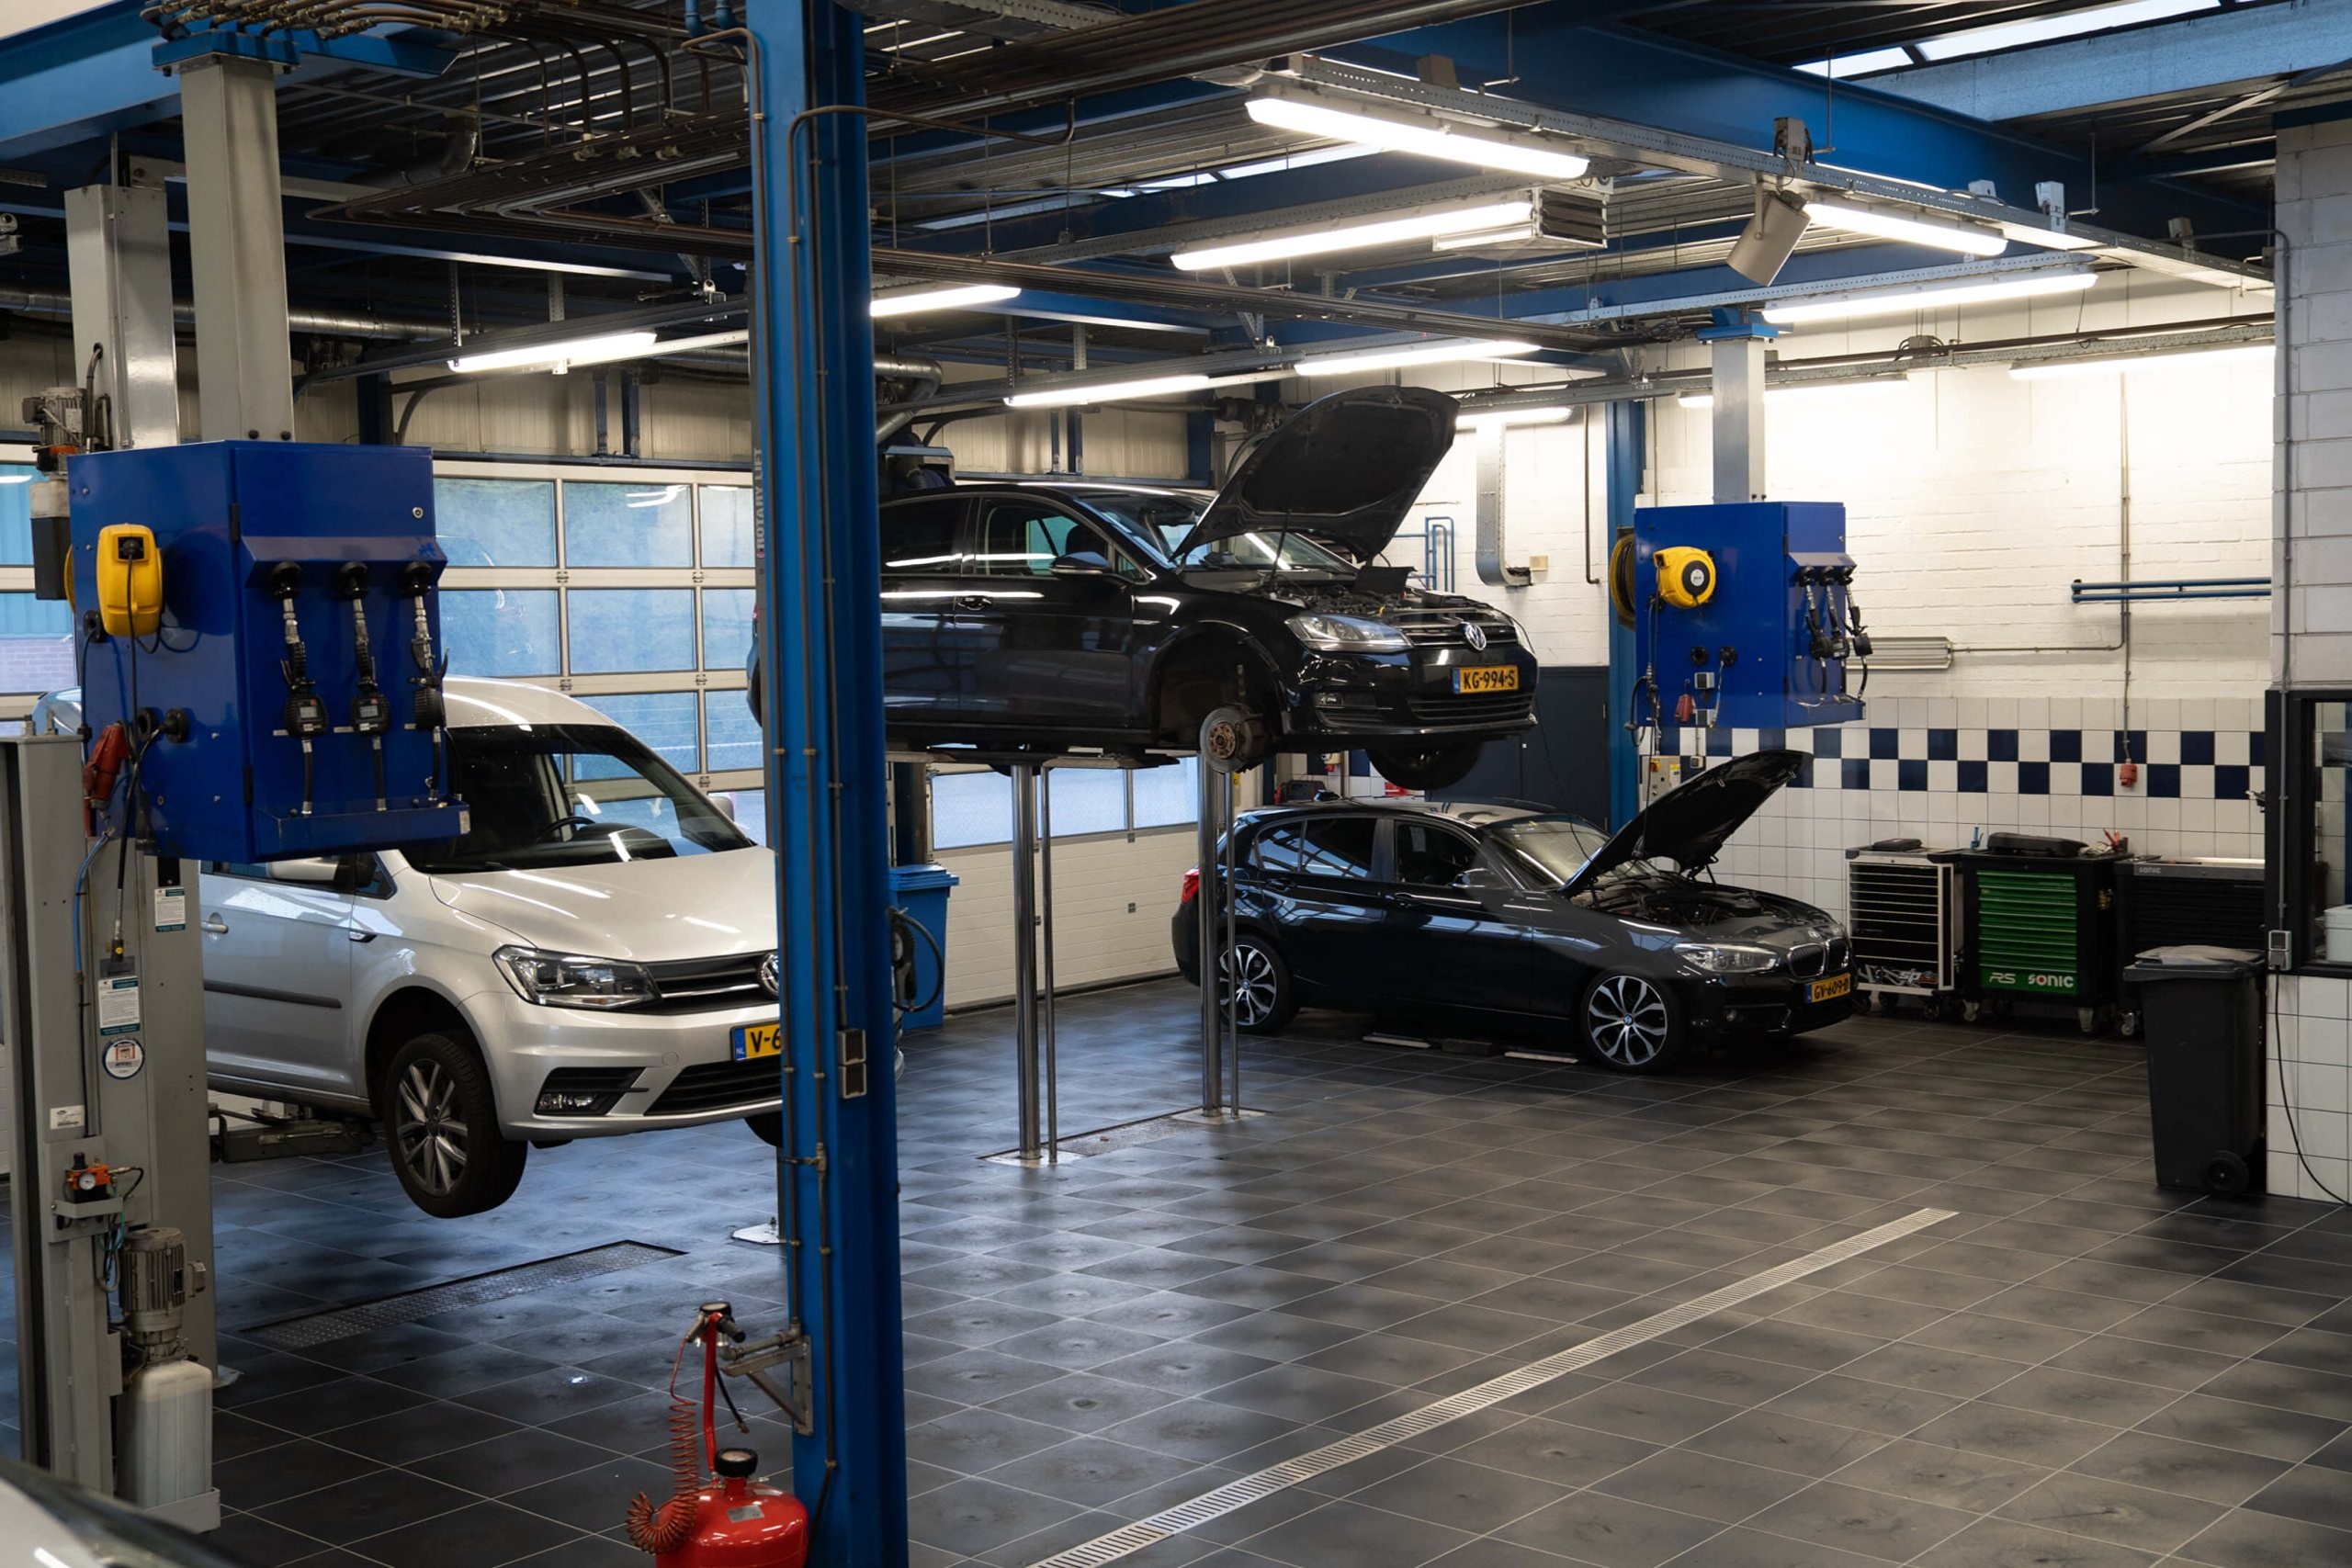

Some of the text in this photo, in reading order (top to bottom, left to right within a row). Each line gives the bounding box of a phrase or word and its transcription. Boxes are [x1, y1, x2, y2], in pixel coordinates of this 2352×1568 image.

[754, 447, 764, 549] ROTARY LIFT
[1464, 669, 1515, 690] KG-994-S
[1989, 972, 2016, 984] RS
